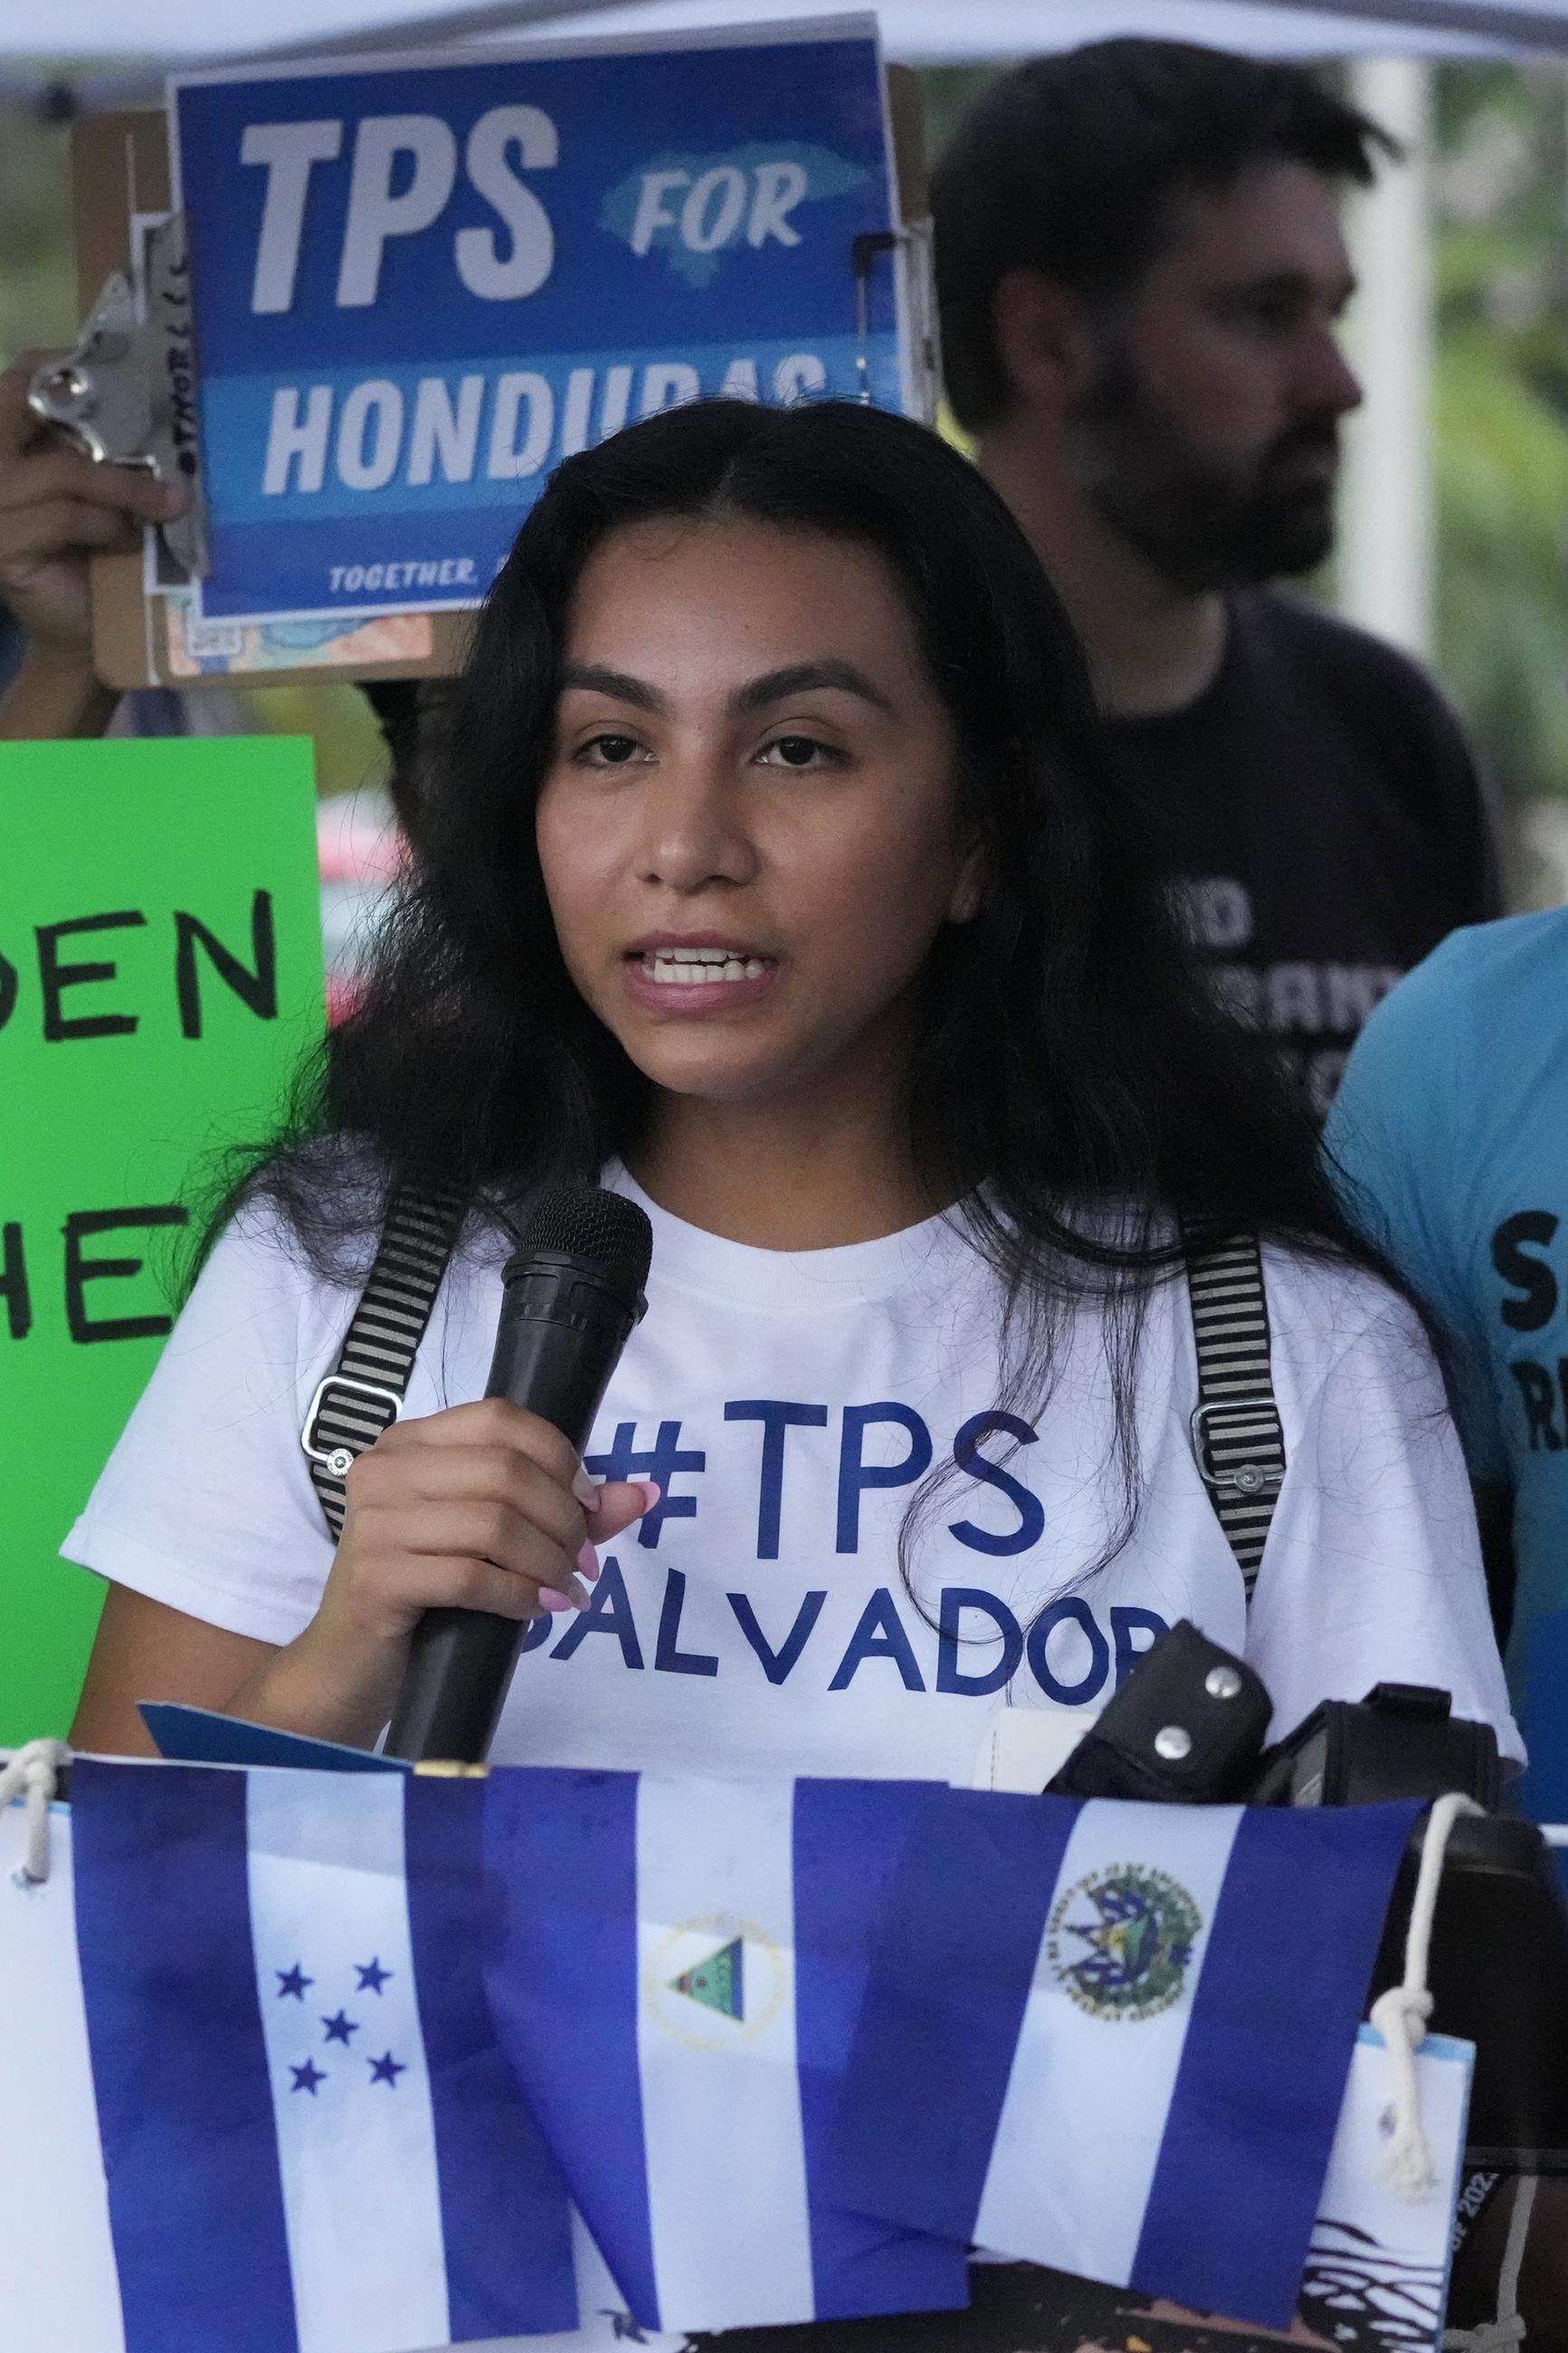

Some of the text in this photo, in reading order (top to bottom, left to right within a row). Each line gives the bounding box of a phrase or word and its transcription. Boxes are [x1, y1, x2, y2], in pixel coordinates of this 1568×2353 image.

[241, 104, 808, 313] TPS FOR
[0, 888, 278, 1043] EN
[1491, 1209, 1568, 1332] S
[582, 1400, 1045, 1560] #TPS
